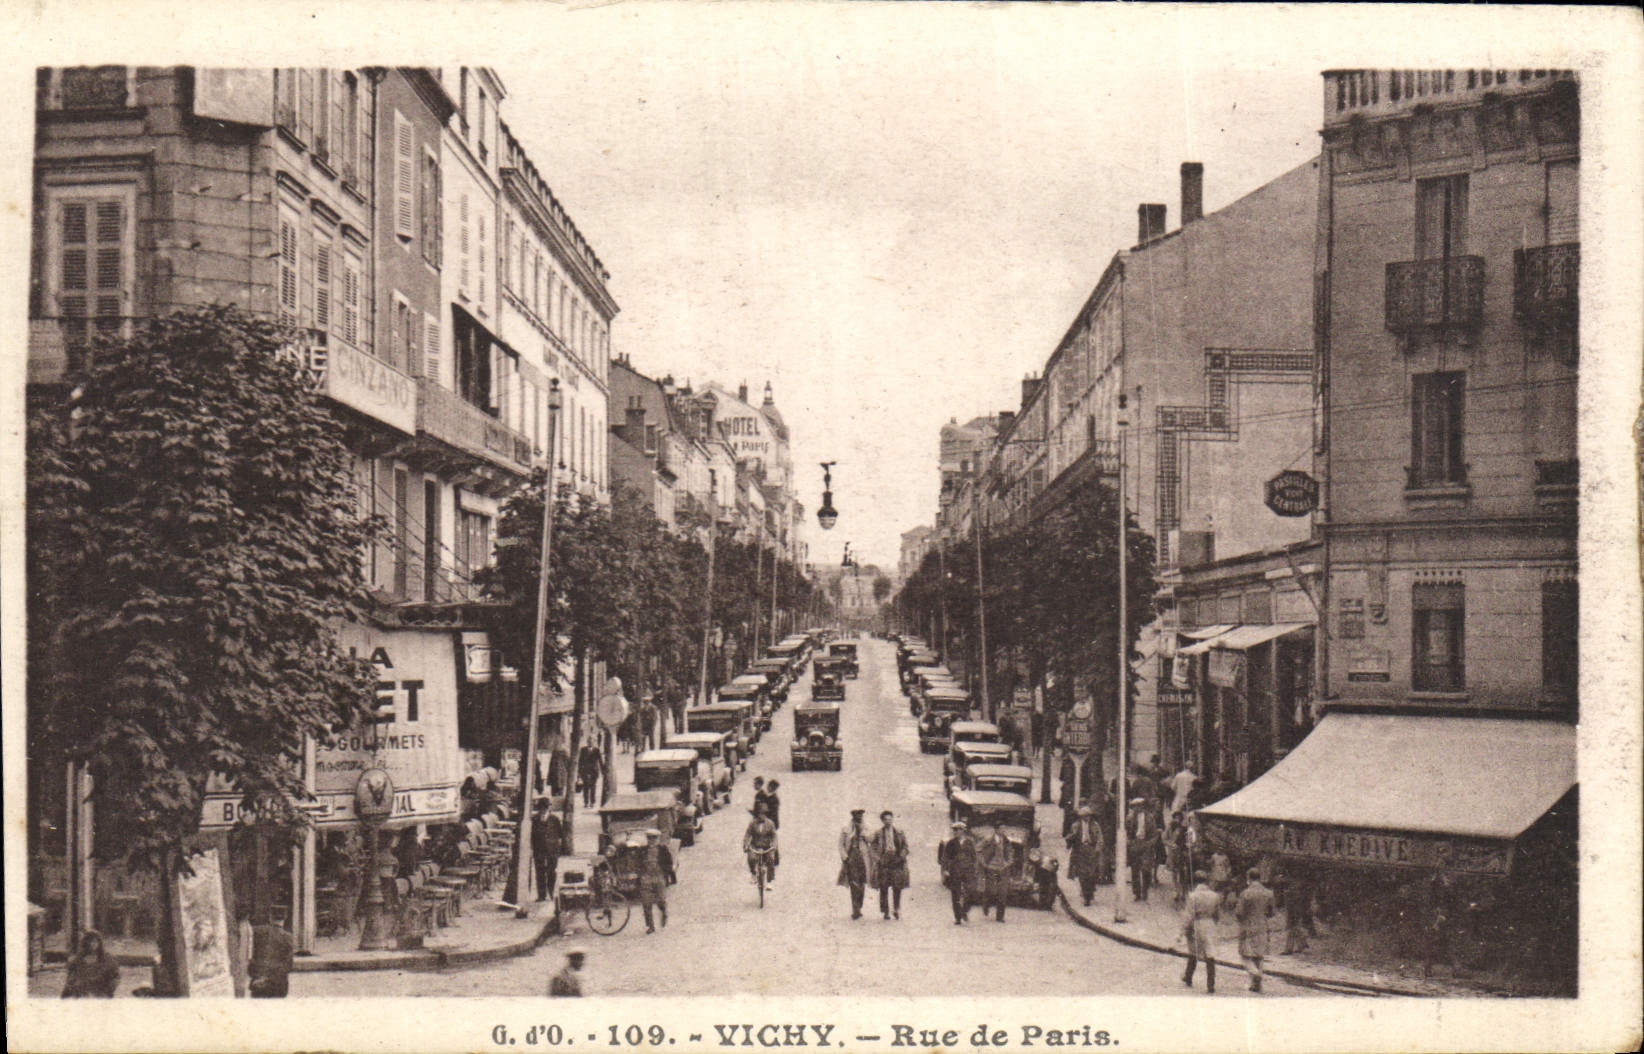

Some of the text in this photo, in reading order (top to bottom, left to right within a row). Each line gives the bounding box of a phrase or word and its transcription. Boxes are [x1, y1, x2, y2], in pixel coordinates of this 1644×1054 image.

[336, 343, 410, 409] CINZANO
[724, 416, 761, 437] HOTEL
[337, 734, 426, 752] GOURMETS
